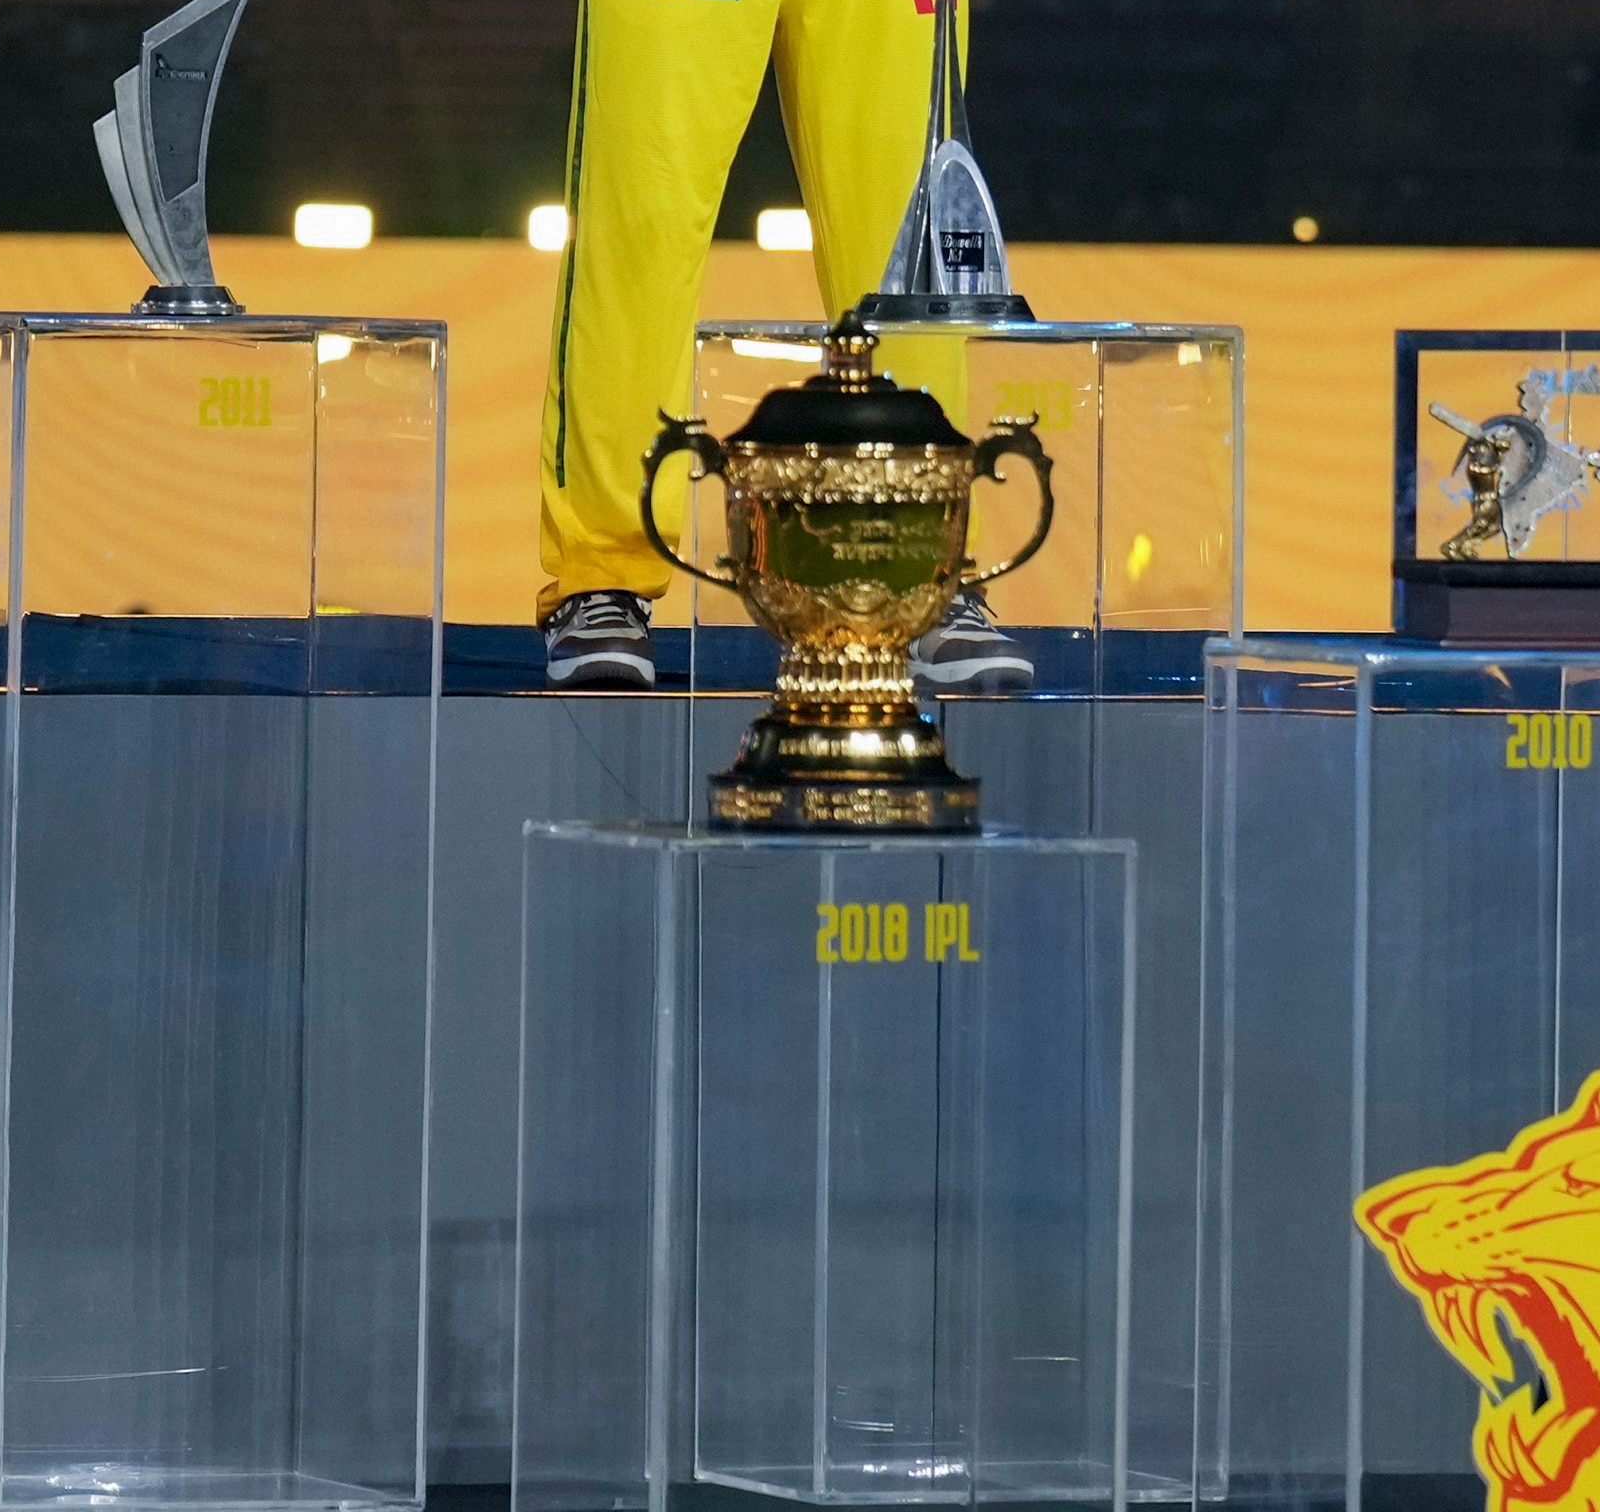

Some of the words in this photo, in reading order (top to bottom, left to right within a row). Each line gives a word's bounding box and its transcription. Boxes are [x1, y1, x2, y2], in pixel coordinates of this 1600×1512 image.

[199, 377, 273, 427] 2011
[1505, 714, 1593, 769] 2010
[815, 903, 908, 963] 2018
[923, 903, 980, 963] IPL
